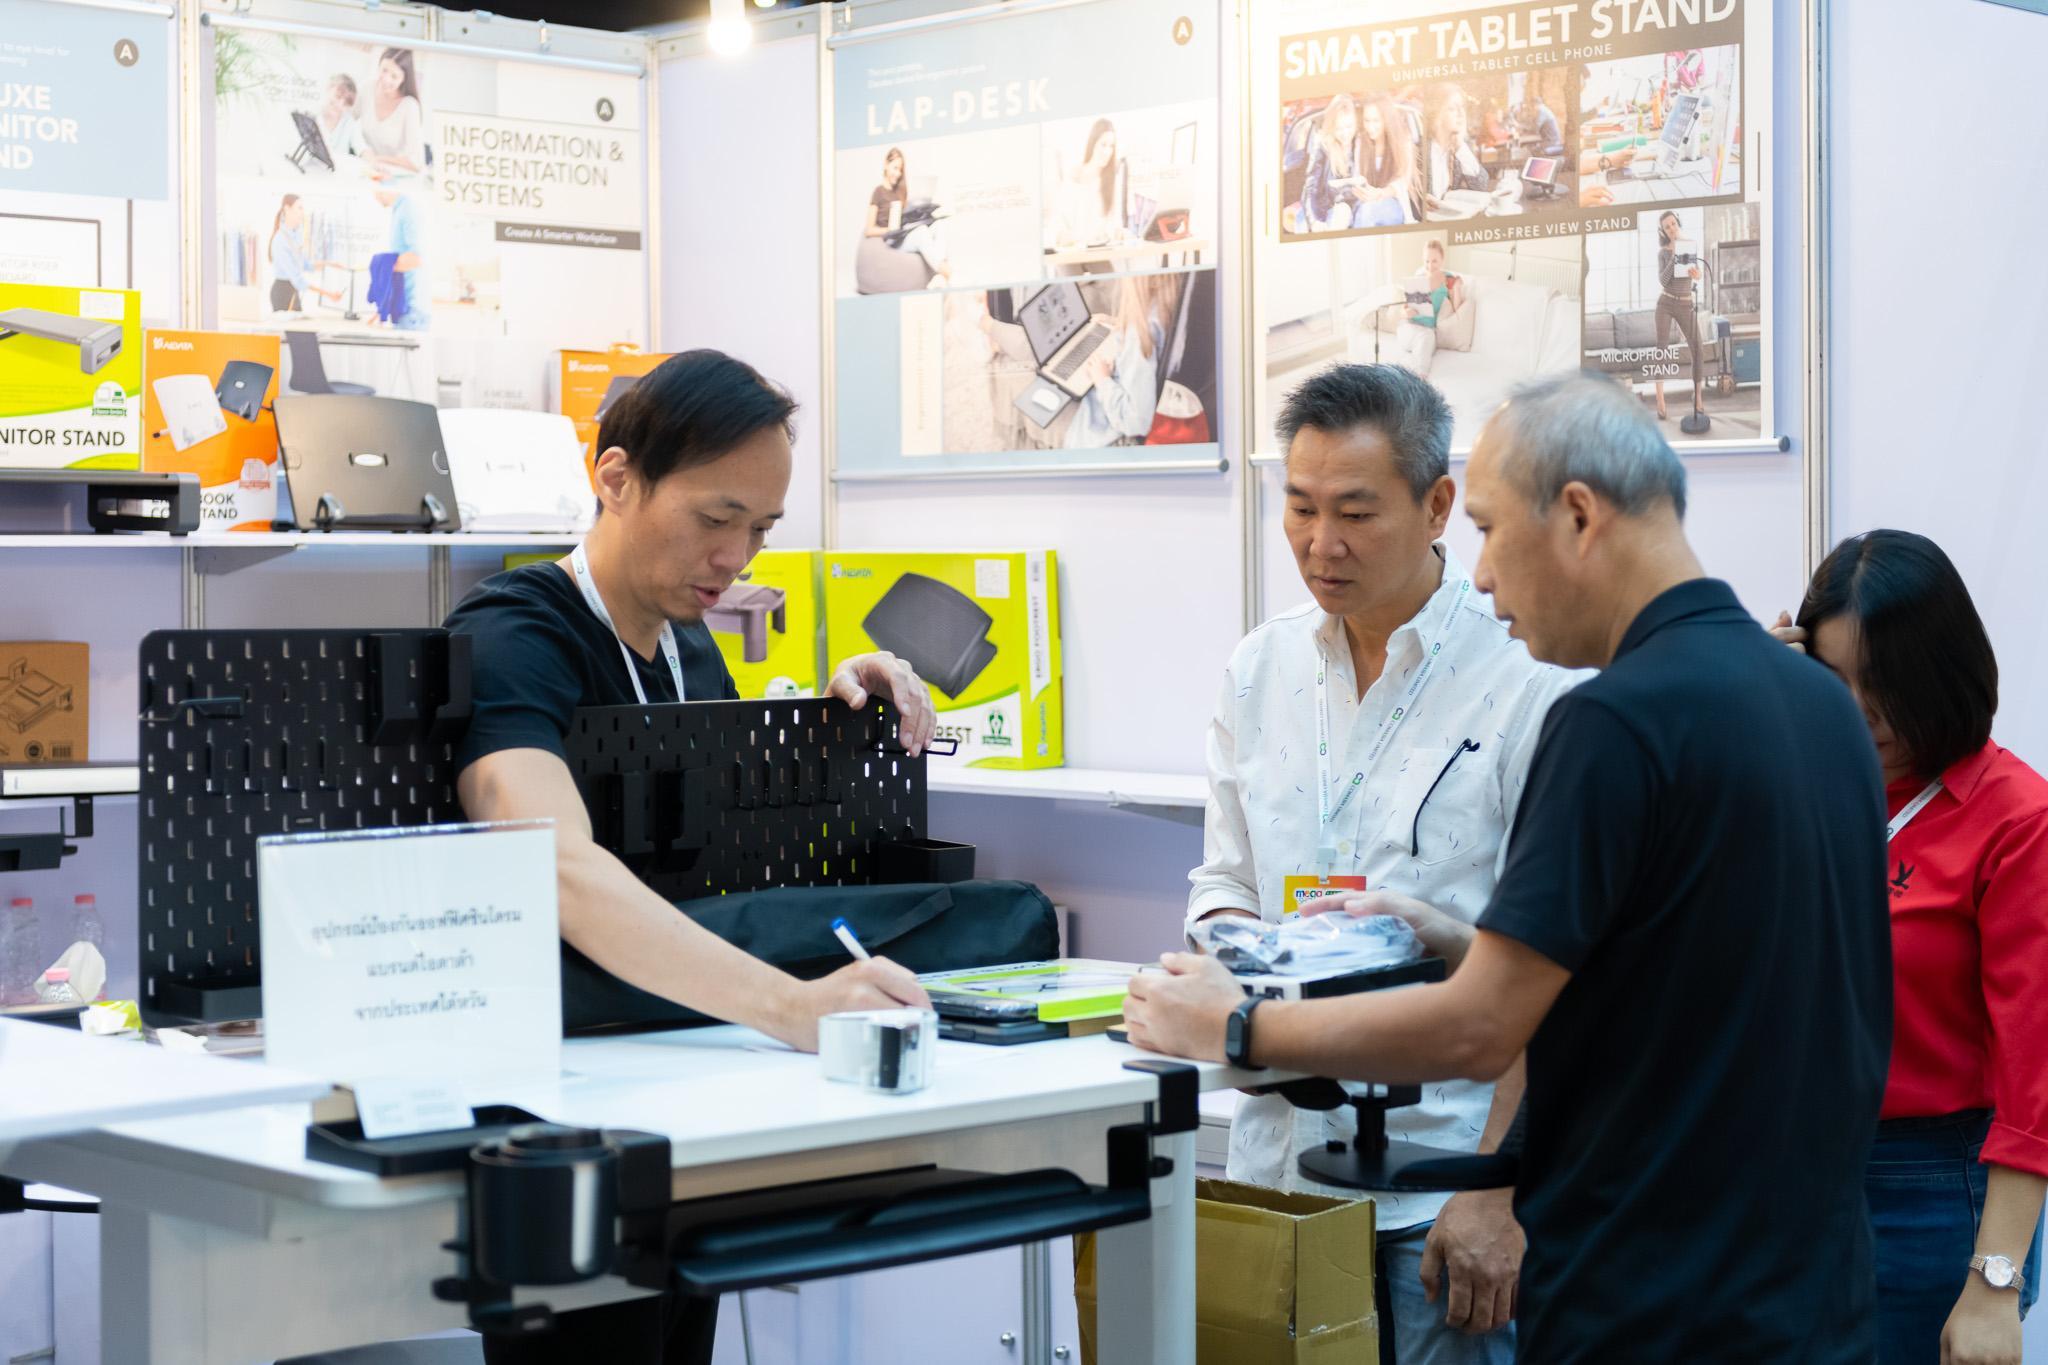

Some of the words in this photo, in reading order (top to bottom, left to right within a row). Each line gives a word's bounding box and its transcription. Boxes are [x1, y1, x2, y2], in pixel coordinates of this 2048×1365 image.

[1284, 27, 1419, 80] SMART
[1429, 5, 1578, 60] TABLET
[1590, 0, 1737, 39] STAND
[1392, 64, 1466, 82] UNIVERSAL
[1471, 56, 1520, 71] TABLET
[1526, 52, 1558, 64] CELL
[1564, 43, 1613, 60] PHONE
[867, 77, 1051, 136] LAP-DESK
[0, 112, 79, 144] NITOR
[0, 143, 33, 170] ND
[443, 125, 602, 160] INFORMATION
[609, 141, 624, 162] &
[444, 152, 608, 187] PRESENTATION
[444, 179, 544, 208] SYSTEMS
[1455, 224, 1540, 243] HANDS-FREE
[1546, 221, 1579, 235] VIEW
[1585, 216, 1631, 232] STAND
[1600, 347, 1679, 363] MICROPHONE
[1641, 363, 1679, 377] STAND
[0, 428, 55, 445] NITOR
[63, 430, 125, 446] STAND
[199, 493, 234, 505] OOK
